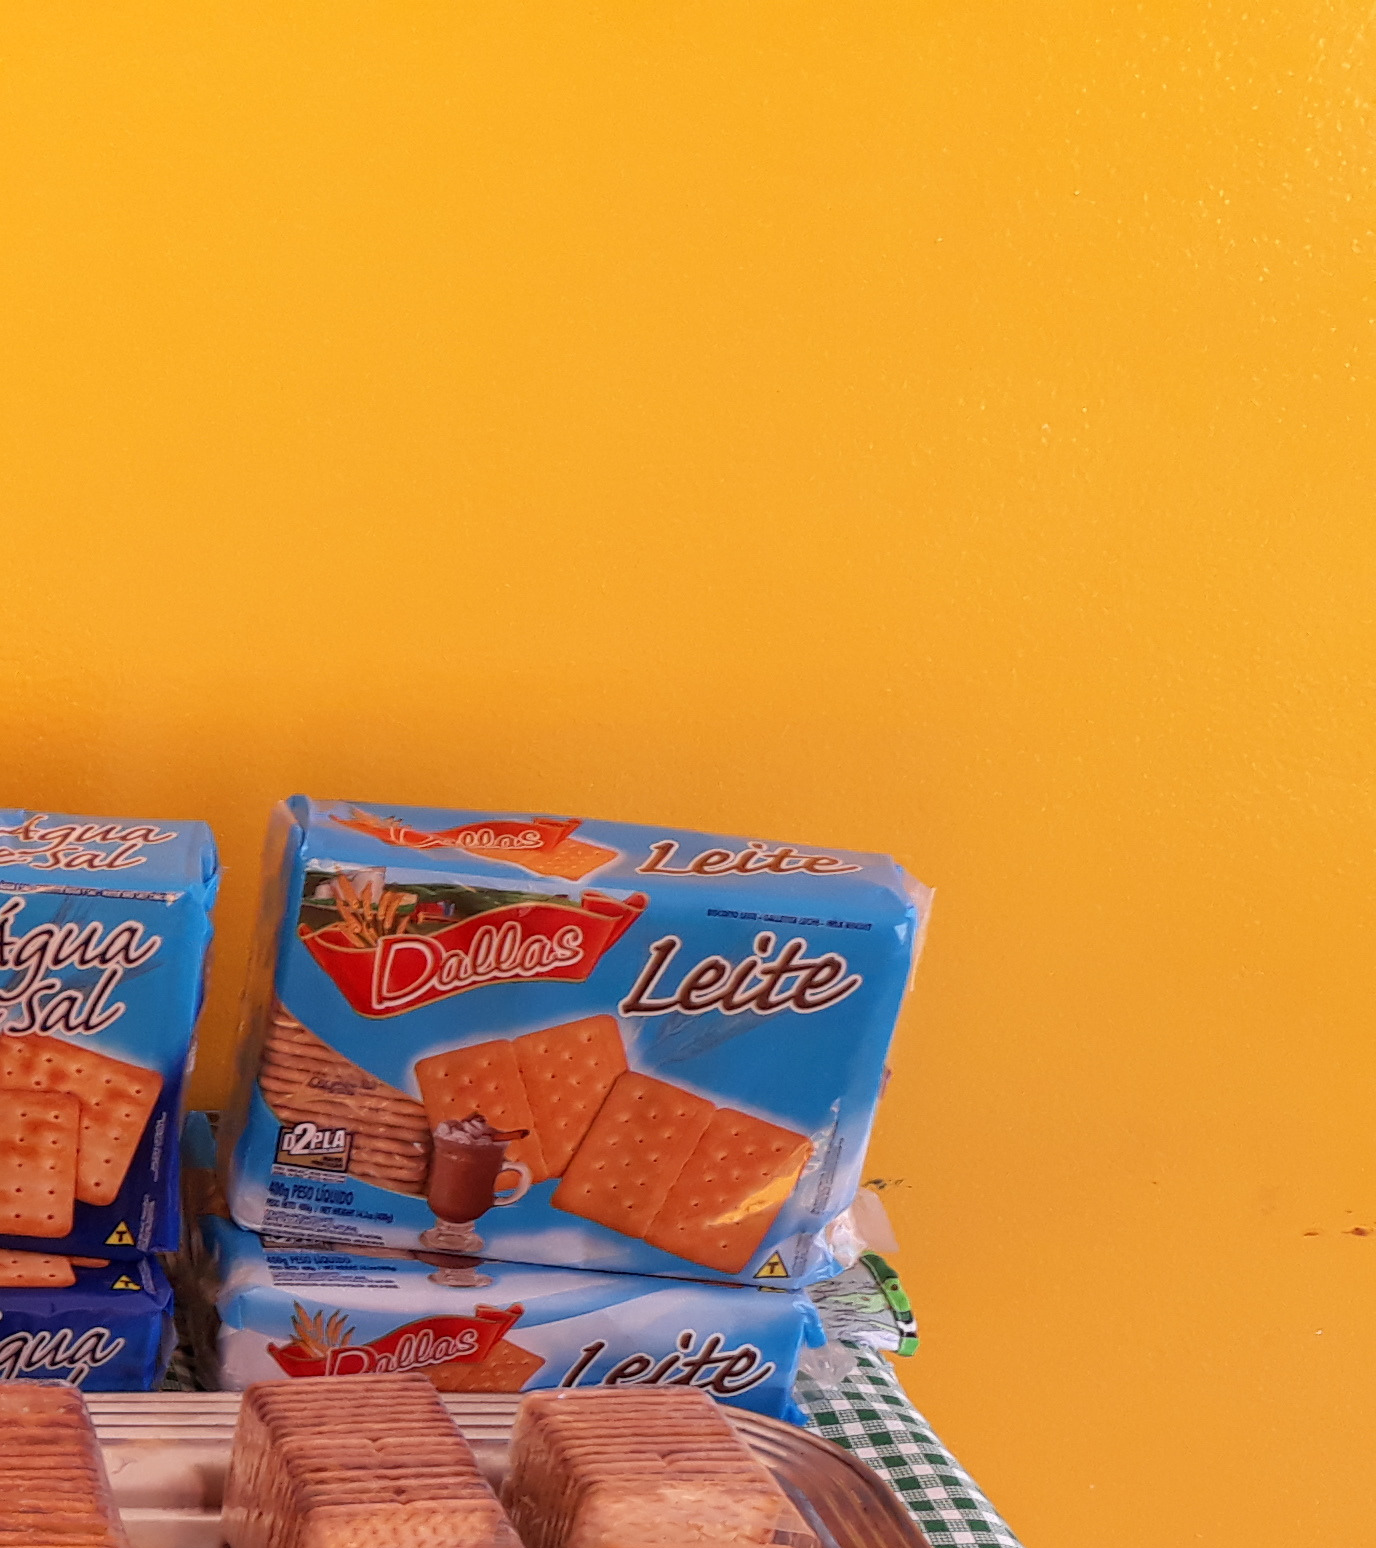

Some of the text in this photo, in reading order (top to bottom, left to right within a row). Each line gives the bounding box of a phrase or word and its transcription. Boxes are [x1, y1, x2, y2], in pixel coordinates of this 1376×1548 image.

[635, 840, 863, 876] Leite
[372, 920, 585, 1009] Dallas
[619, 931, 862, 1017] Leite
[5, 965, 125, 1036] sal
[559, 1328, 776, 1397] Leite
